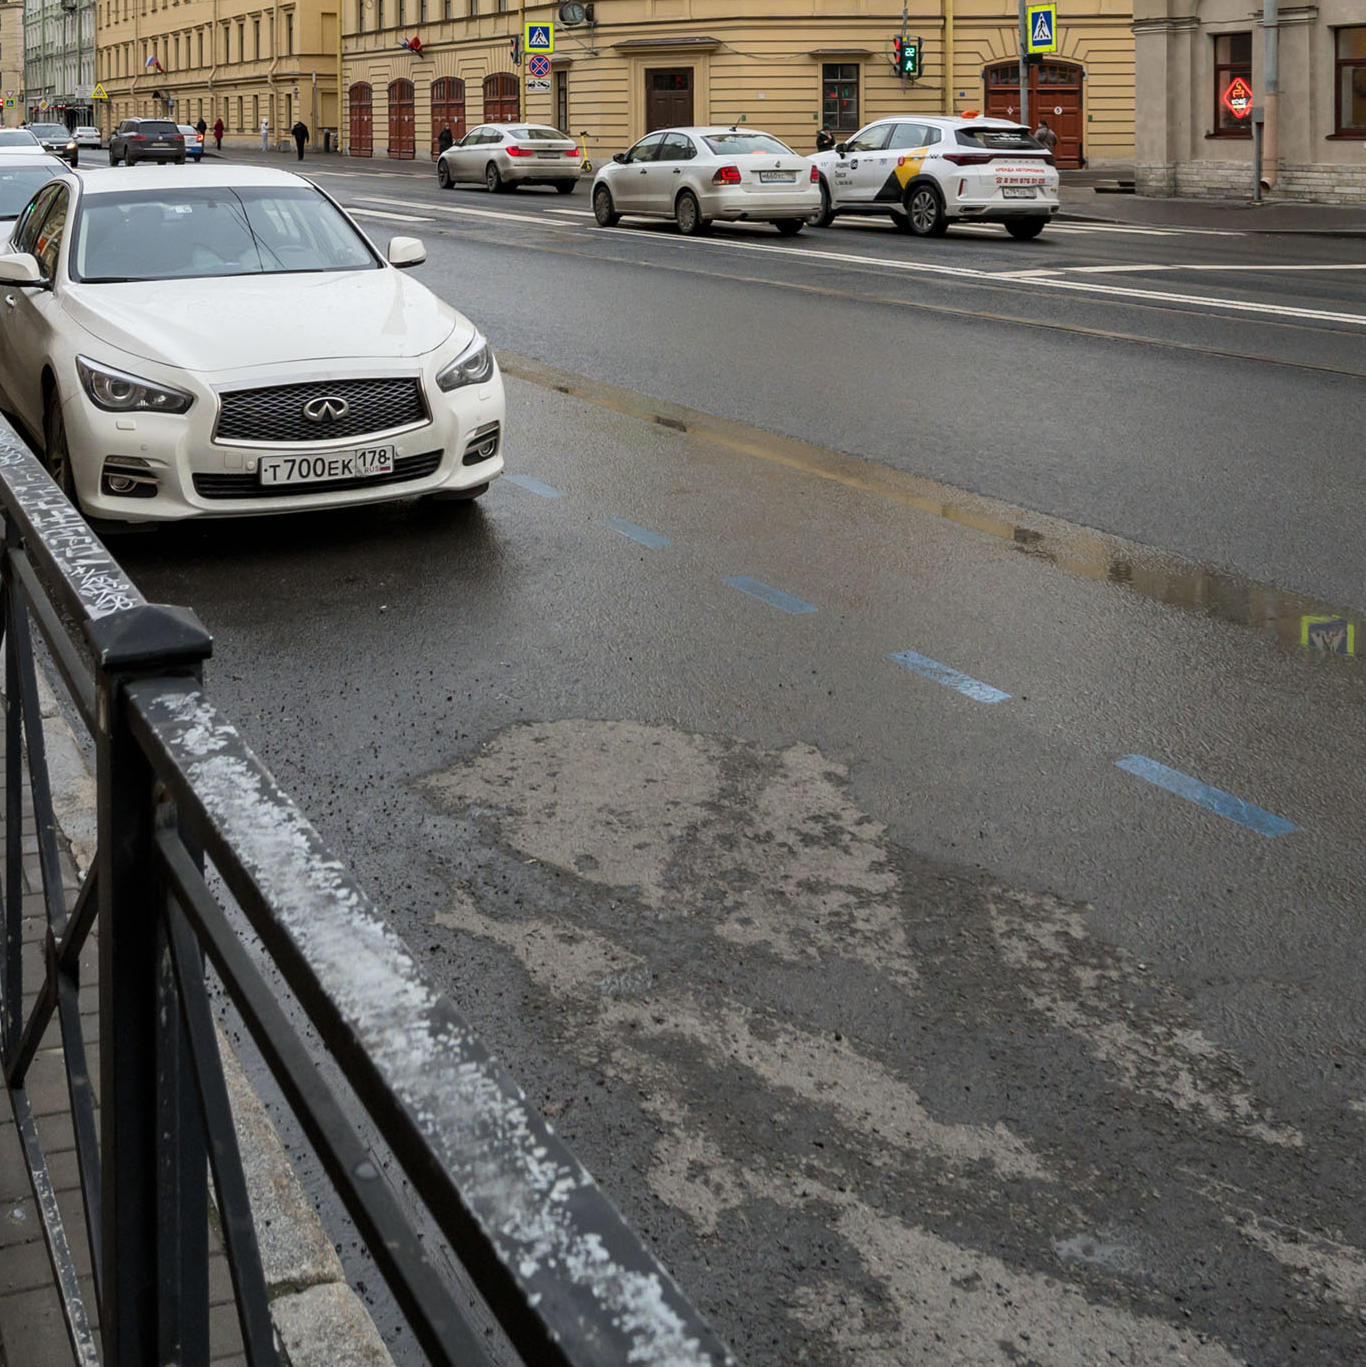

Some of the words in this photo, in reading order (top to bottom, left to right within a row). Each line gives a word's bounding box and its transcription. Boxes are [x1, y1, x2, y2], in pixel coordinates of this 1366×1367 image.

[269, 457, 353, 482] Т700ЕК
[358, 449, 388, 467] 178
[364, 466, 379, 474] RUS
